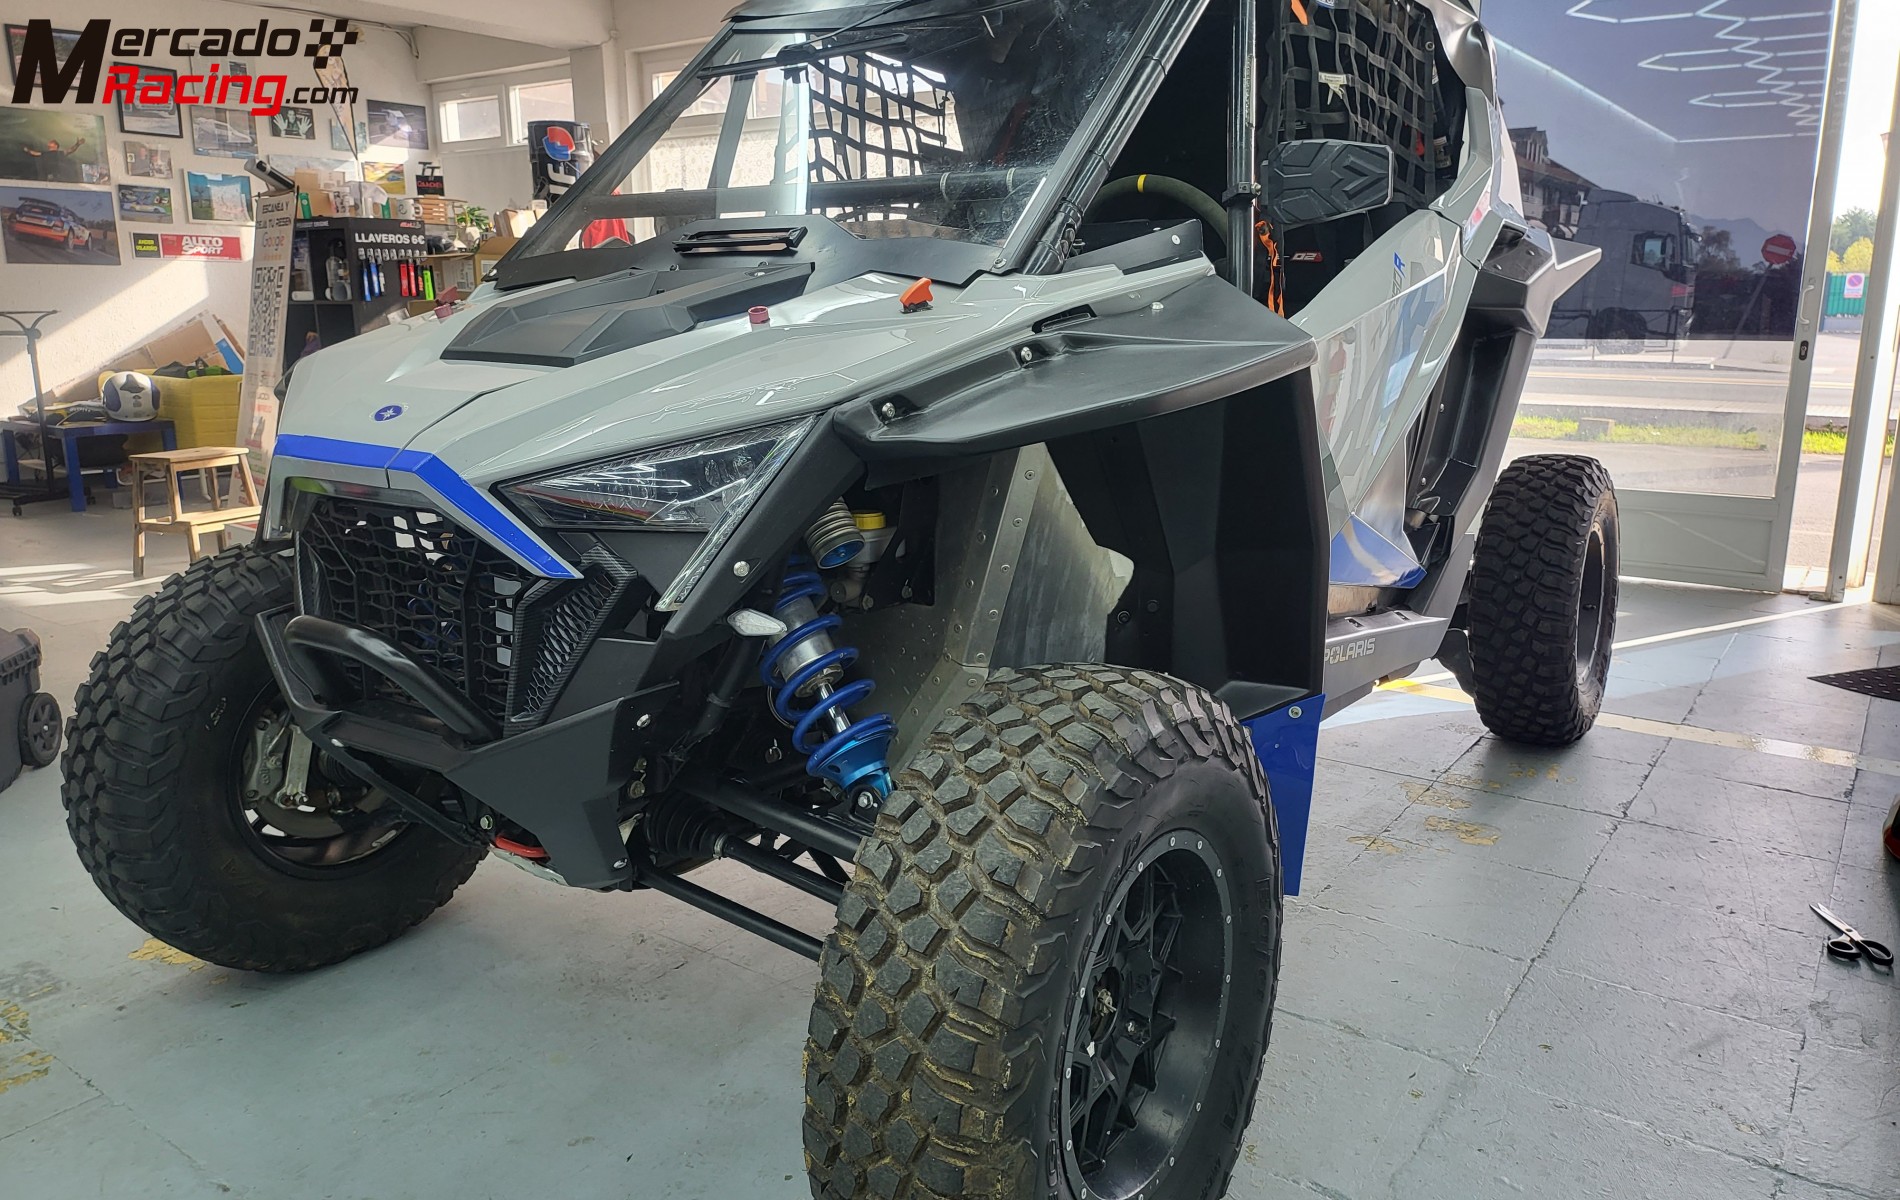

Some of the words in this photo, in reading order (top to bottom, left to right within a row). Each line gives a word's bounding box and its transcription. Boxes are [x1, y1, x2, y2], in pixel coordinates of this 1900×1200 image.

[182, 236, 223, 247] AUTO
[354, 232, 410, 245] LLAVEROS
[411, 234, 425, 245] 6€
[181, 245, 224, 255] SPORT
[1324, 637, 1376, 665] POLARIS
